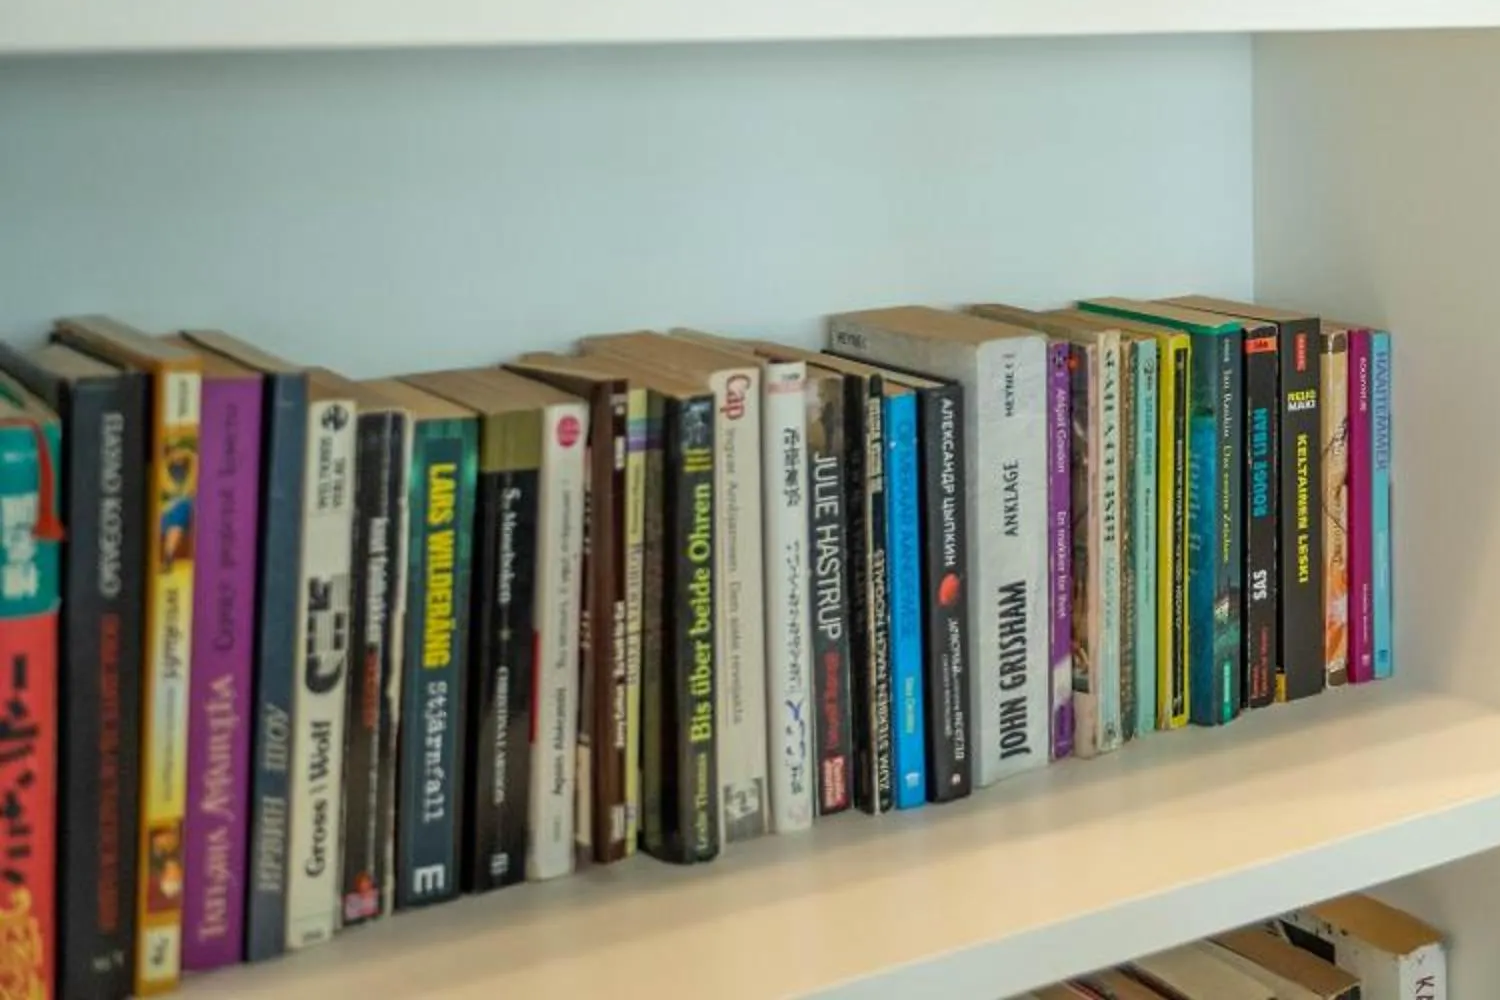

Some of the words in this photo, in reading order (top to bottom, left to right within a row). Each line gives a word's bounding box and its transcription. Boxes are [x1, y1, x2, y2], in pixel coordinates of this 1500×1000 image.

[721, 373, 753, 420] Cap
[940, 398, 956, 494] АЛЕКСАНДР
[427, 463, 457, 526] LARS
[813, 453, 841, 518] JULIE
[1002, 459, 1020, 537] ANKLAGE
[1296, 434, 1309, 529] KELTAINEN
[689, 484, 712, 562] Ohren
[940, 498, 957, 567] ЦЫПКИН
[815, 524, 842, 641] HASTRUP
[1252, 569, 1268, 601] SAS
[1296, 534, 1309, 583] LESKI
[422, 531, 457, 667] WILDERÄNG
[687, 569, 712, 633] beide
[690, 638, 712, 696] über
[999, 580, 1028, 690] GRISHAM
[306, 721, 333, 782] Wolf
[422, 681, 449, 824] Stjärnfall
[689, 701, 712, 741] Bis
[999, 695, 1031, 758] JOHN
[304, 799, 329, 878] Gross
